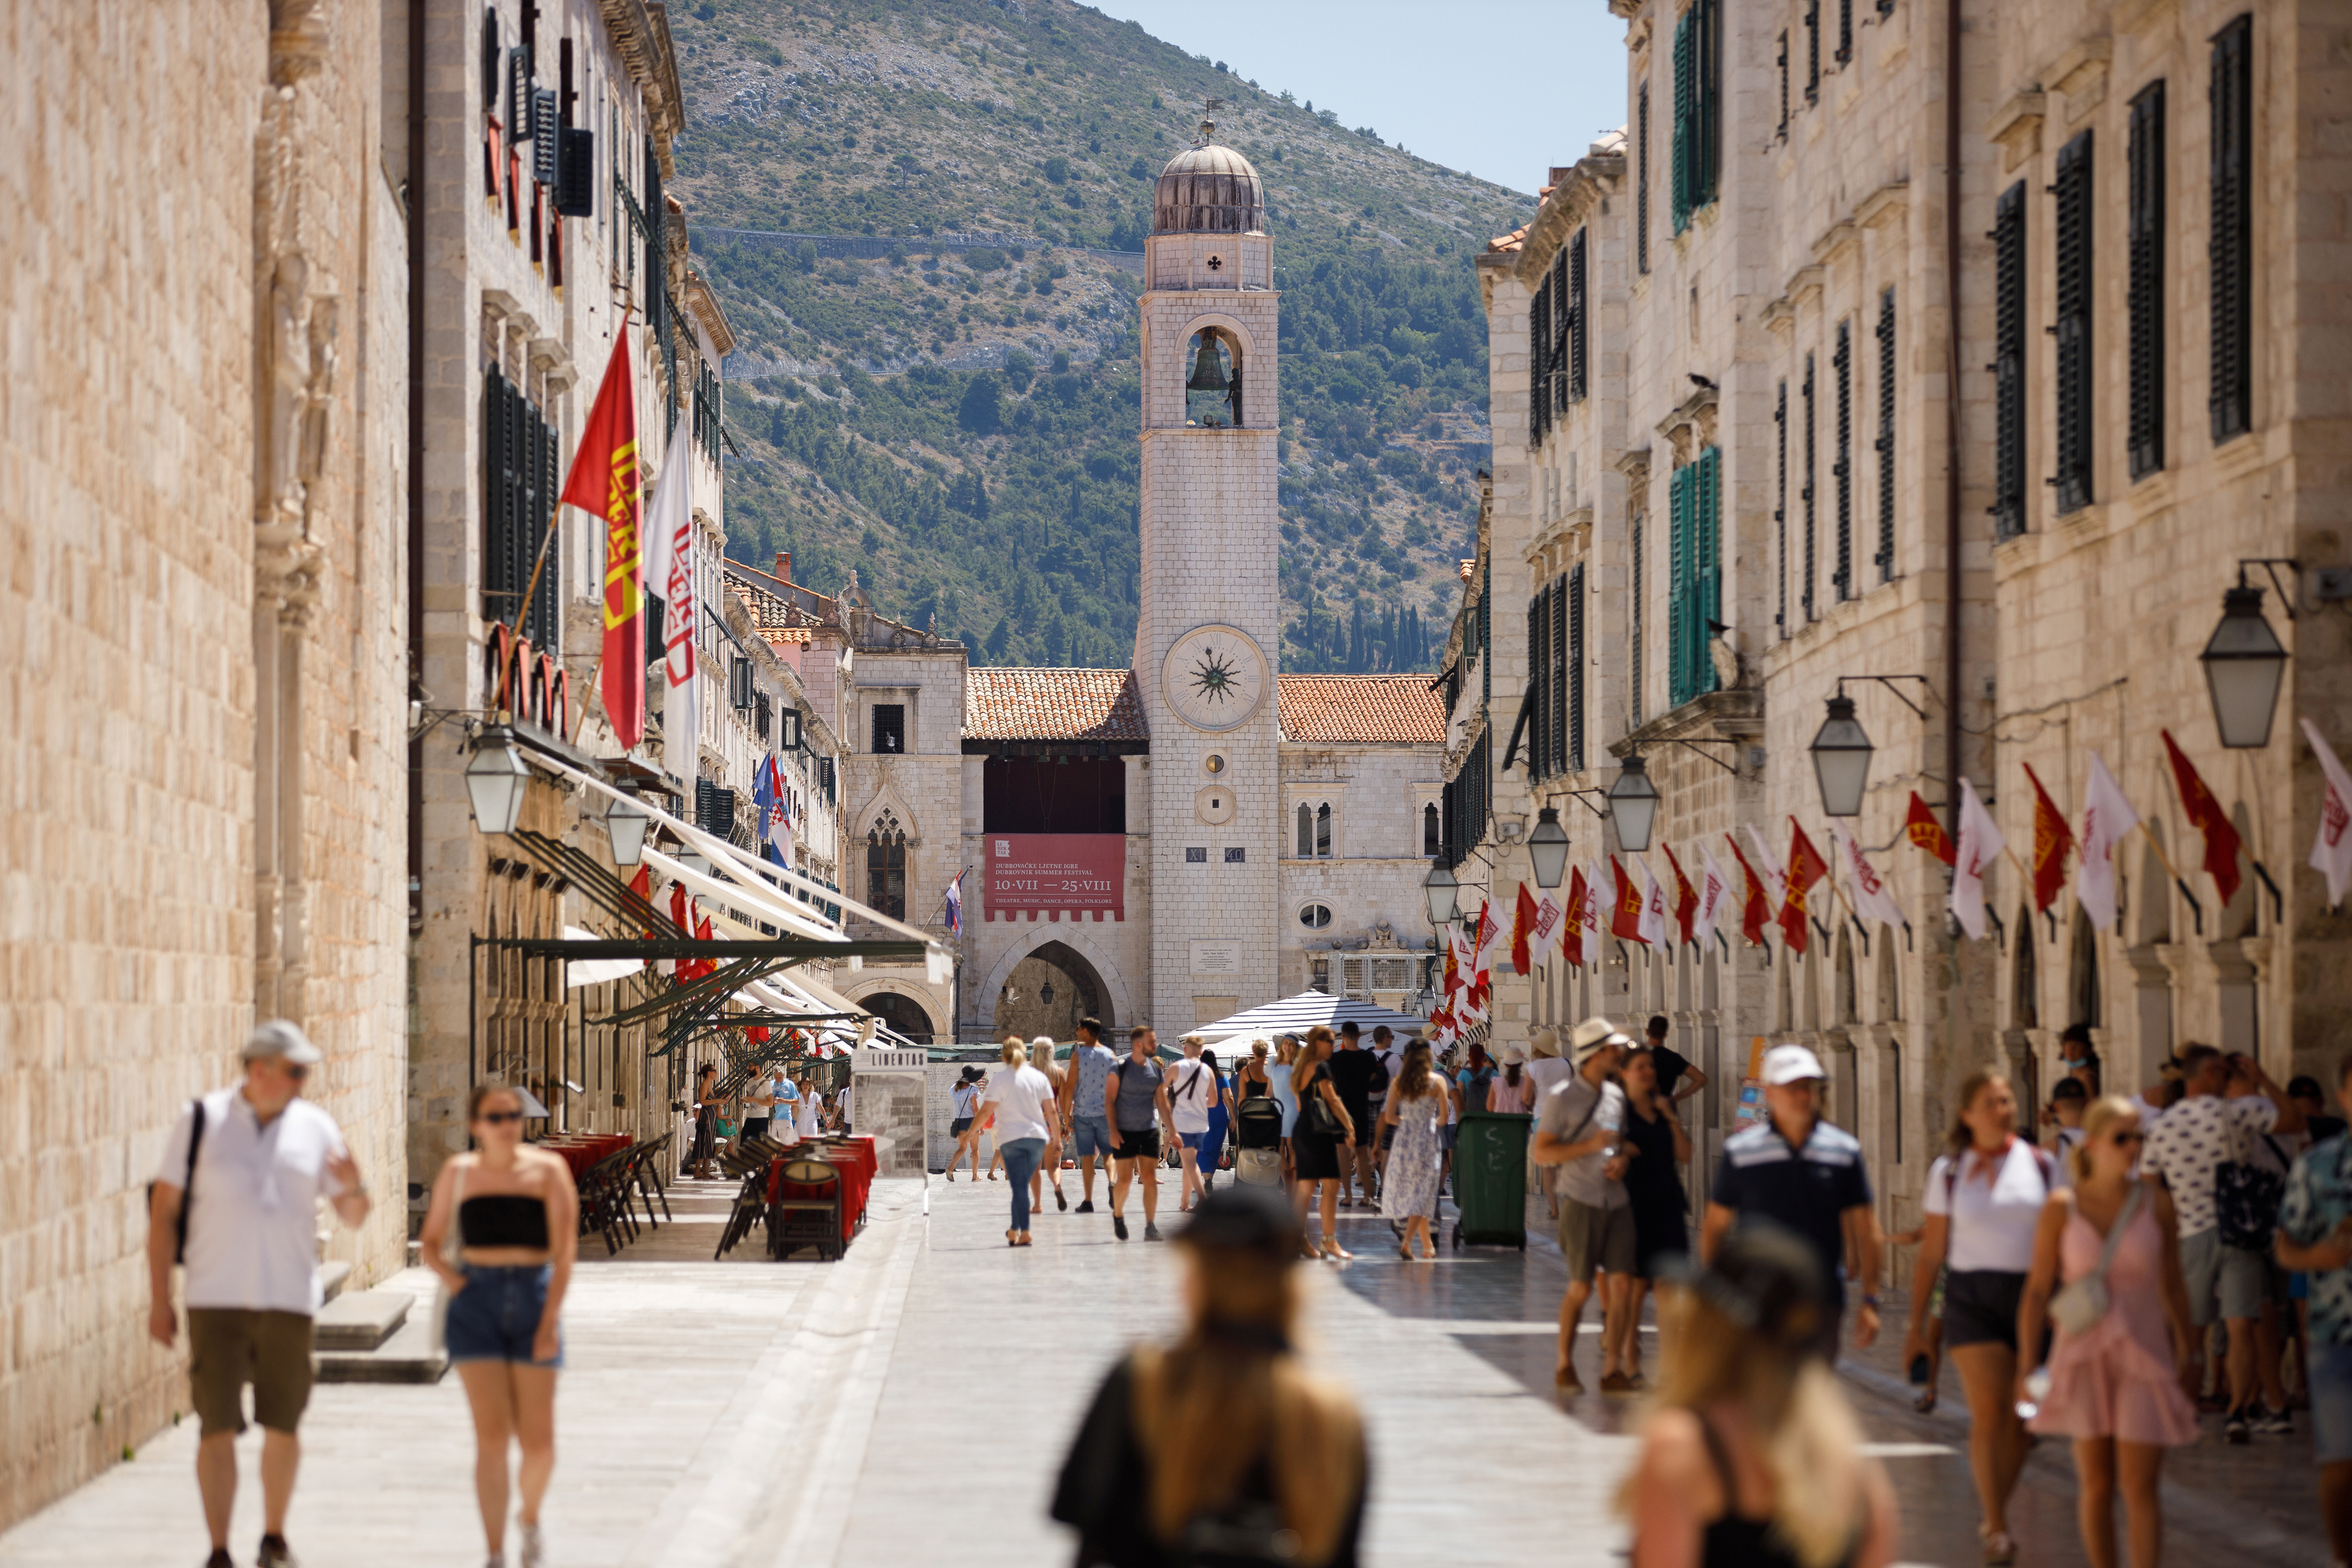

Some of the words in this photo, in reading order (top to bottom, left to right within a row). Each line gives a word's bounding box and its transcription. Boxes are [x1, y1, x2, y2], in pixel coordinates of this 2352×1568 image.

[1190, 638, 1202, 652] XI
[1209, 634, 1220, 645] XII
[1175, 654, 1187, 664] X
[1243, 654, 1254, 663] II
[1190, 849, 1204, 860] XI
[1227, 849, 1242, 860] 40
[872, 1053, 924, 1066] LIBERTAS
